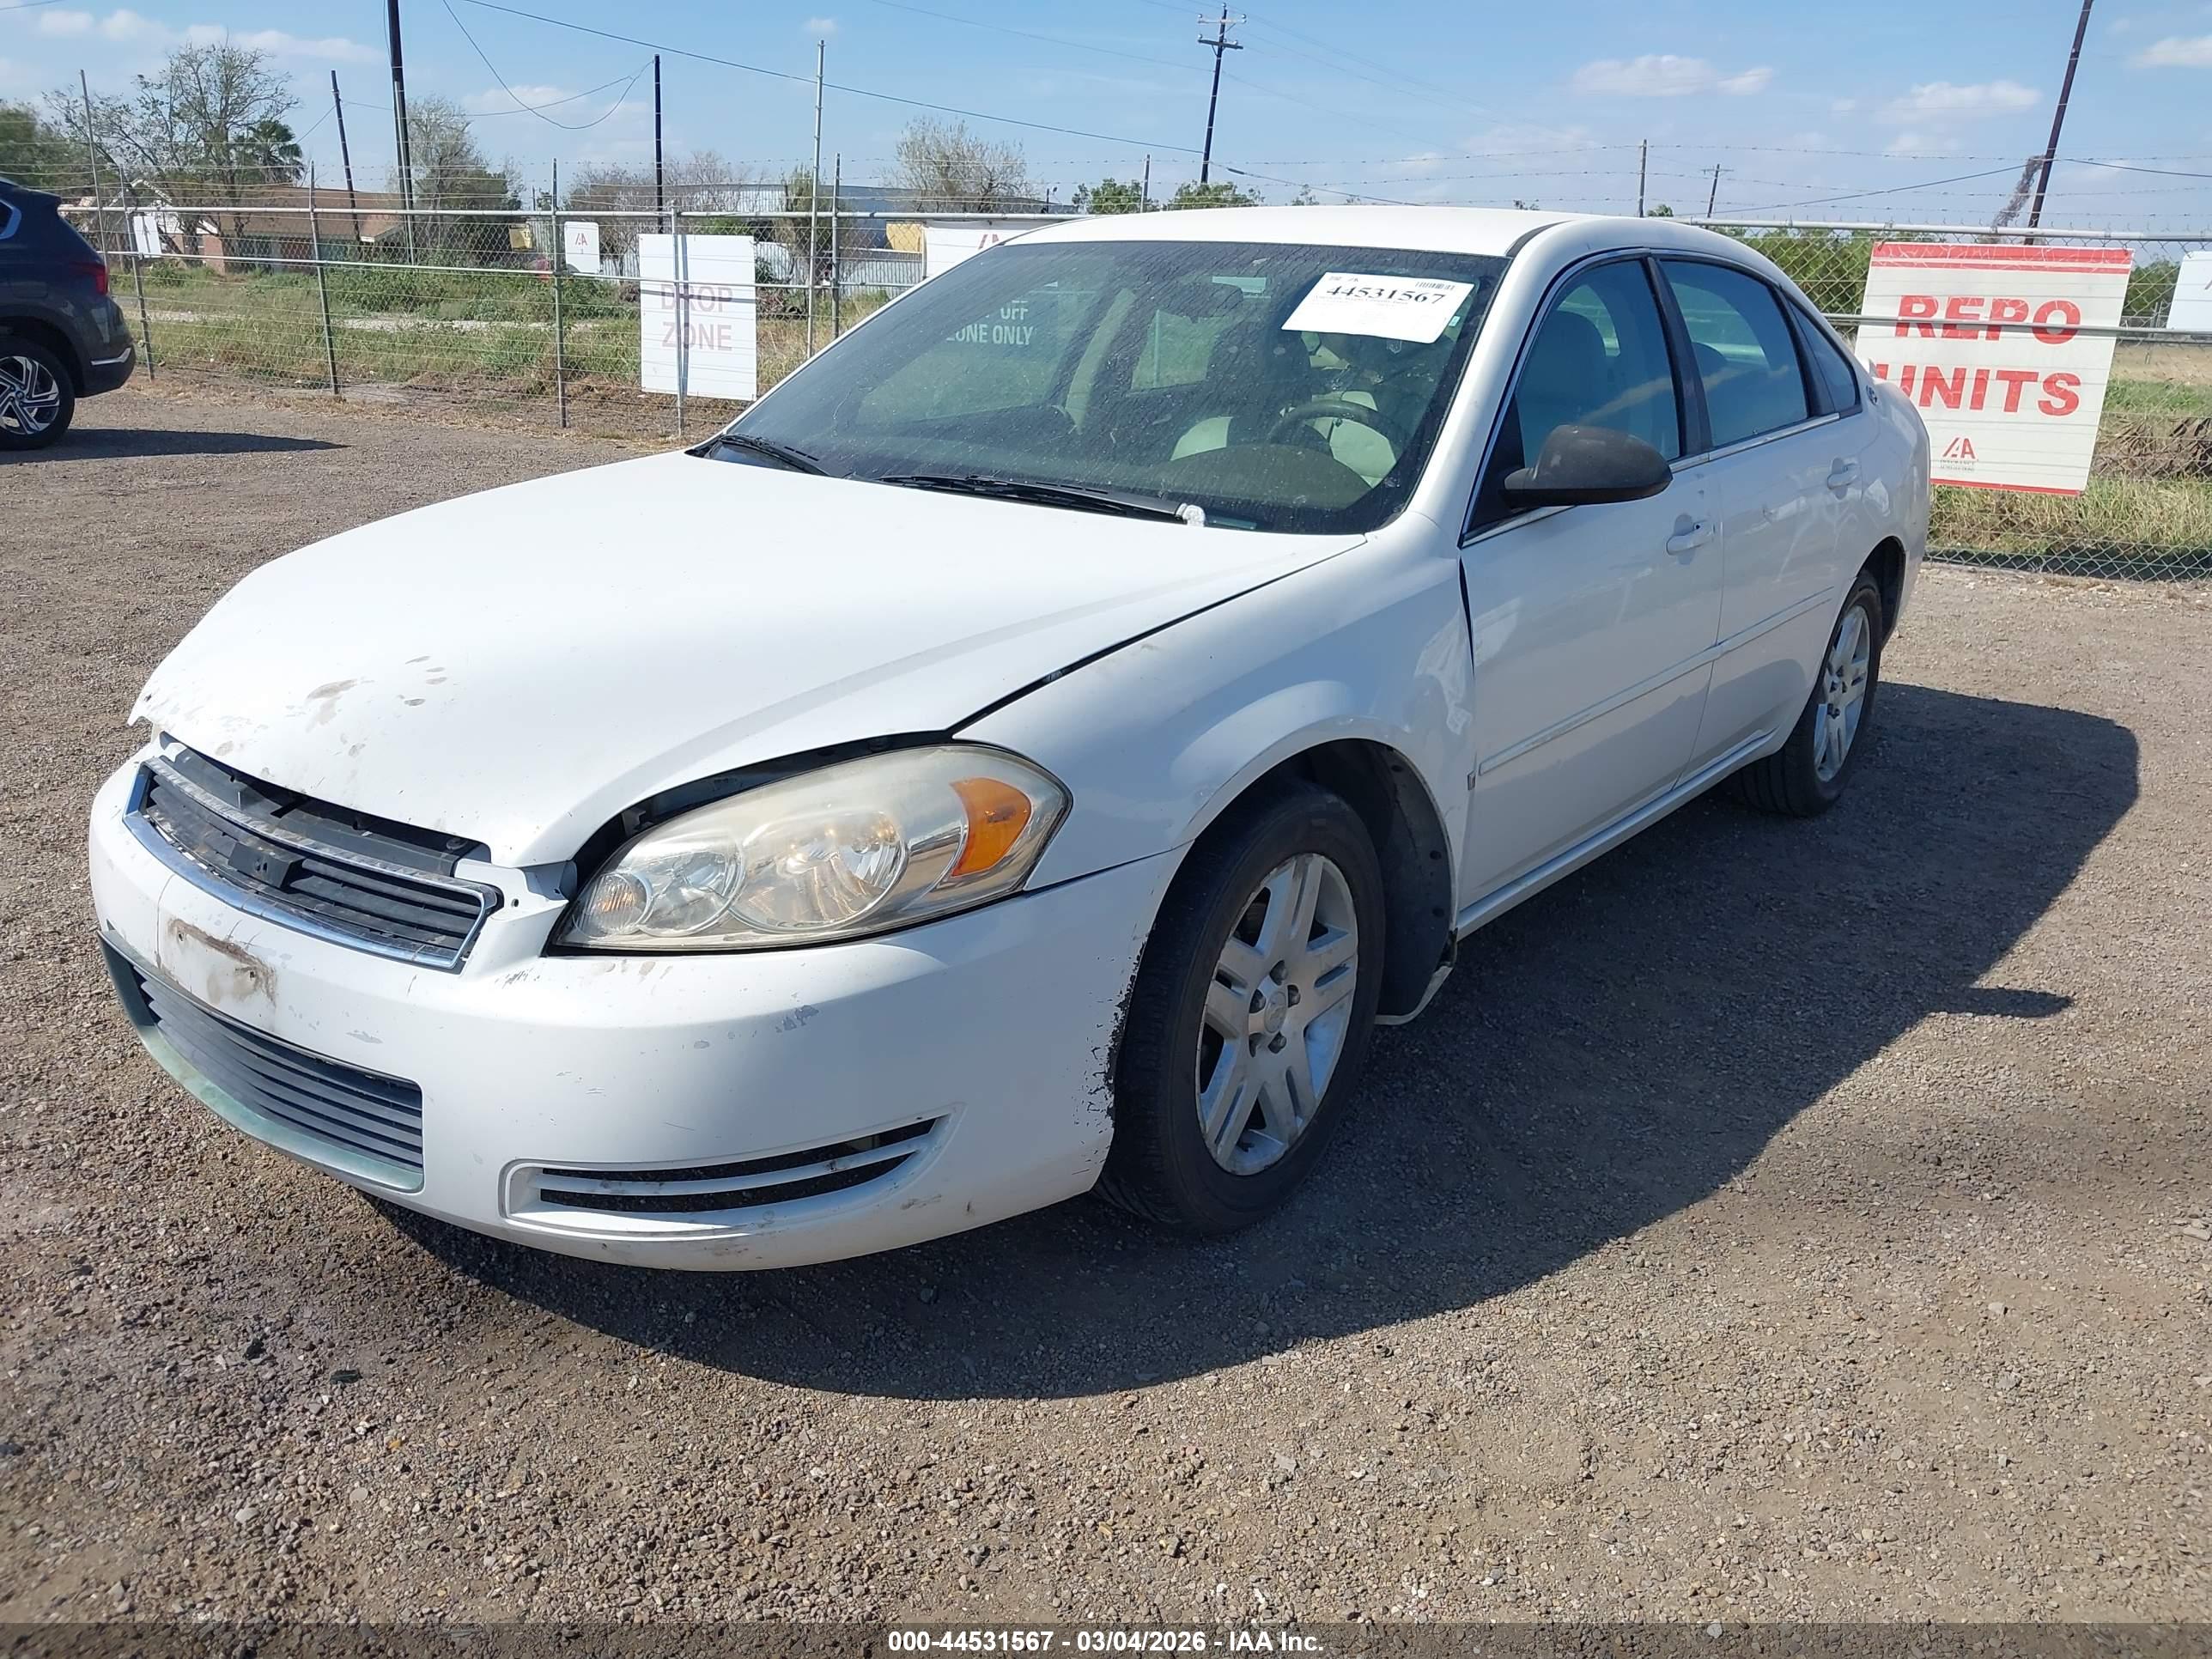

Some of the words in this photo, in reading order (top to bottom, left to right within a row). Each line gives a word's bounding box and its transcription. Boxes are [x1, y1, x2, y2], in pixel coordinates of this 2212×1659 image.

[660, 283, 733, 313] DROP
[1327, 285, 1447, 305] 44531567
[945, 323, 988, 343] ONE
[992, 325, 1034, 345] ONLY
[1894, 295, 2081, 344] REPO
[661, 321, 732, 351] ZONE
